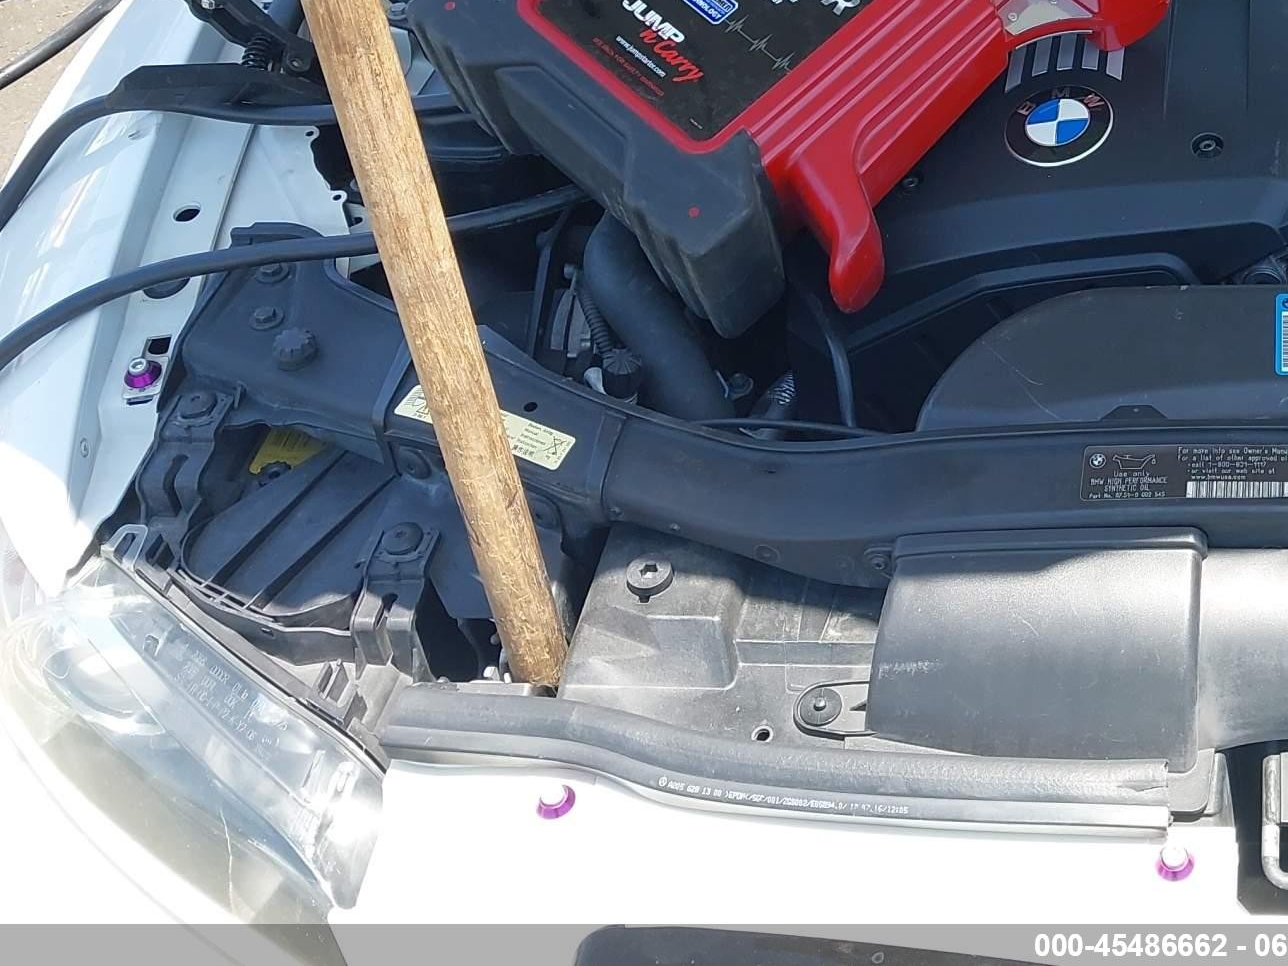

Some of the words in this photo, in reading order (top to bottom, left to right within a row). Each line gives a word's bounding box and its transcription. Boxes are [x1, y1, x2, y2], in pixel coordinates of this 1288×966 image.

[615, 35, 666, 78] www.jumpstarter.com
[653, 40, 704, 82] Carry
[1017, 88, 1105, 116] BMW
[1091, 478, 1106, 486] BMW
[1108, 477, 1123, 485] HIGH
[1124, 476, 1168, 484] PERFORMANCE
[1134, 470, 1150, 478] only
